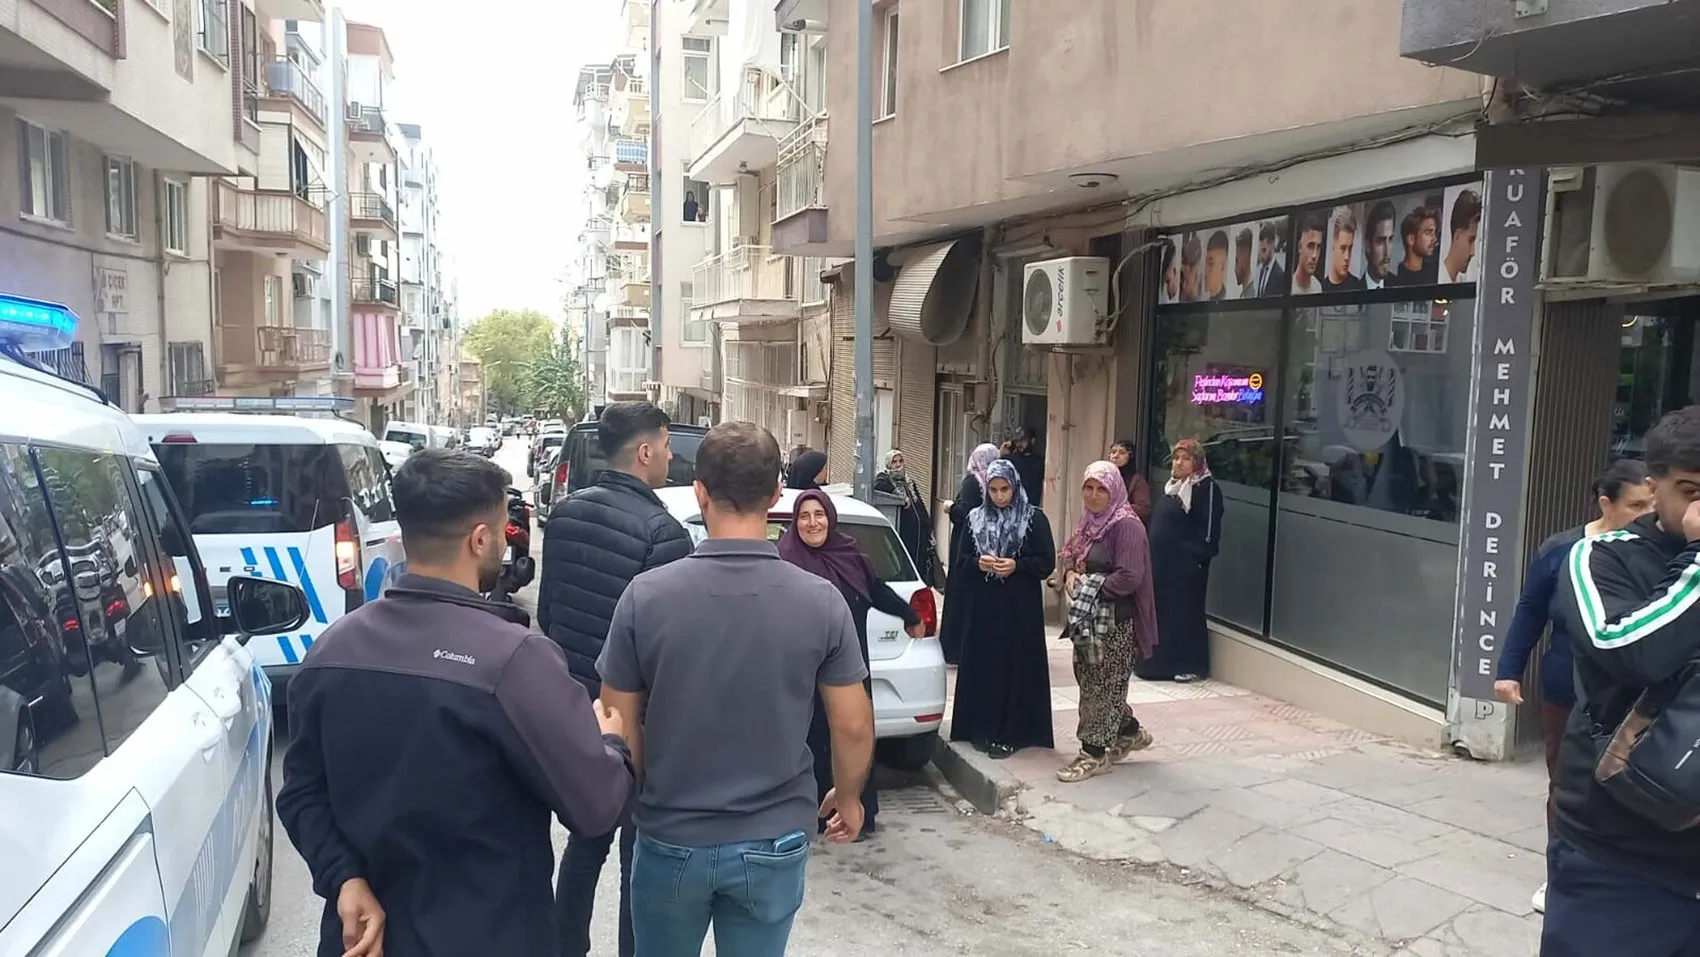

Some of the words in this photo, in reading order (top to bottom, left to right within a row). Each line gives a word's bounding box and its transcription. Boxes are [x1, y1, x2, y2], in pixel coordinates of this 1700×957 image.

[1489, 338, 1515, 480] MEHMET
[440, 650, 475, 664] Columbia
[1478, 512, 1502, 675] DERİNCE
